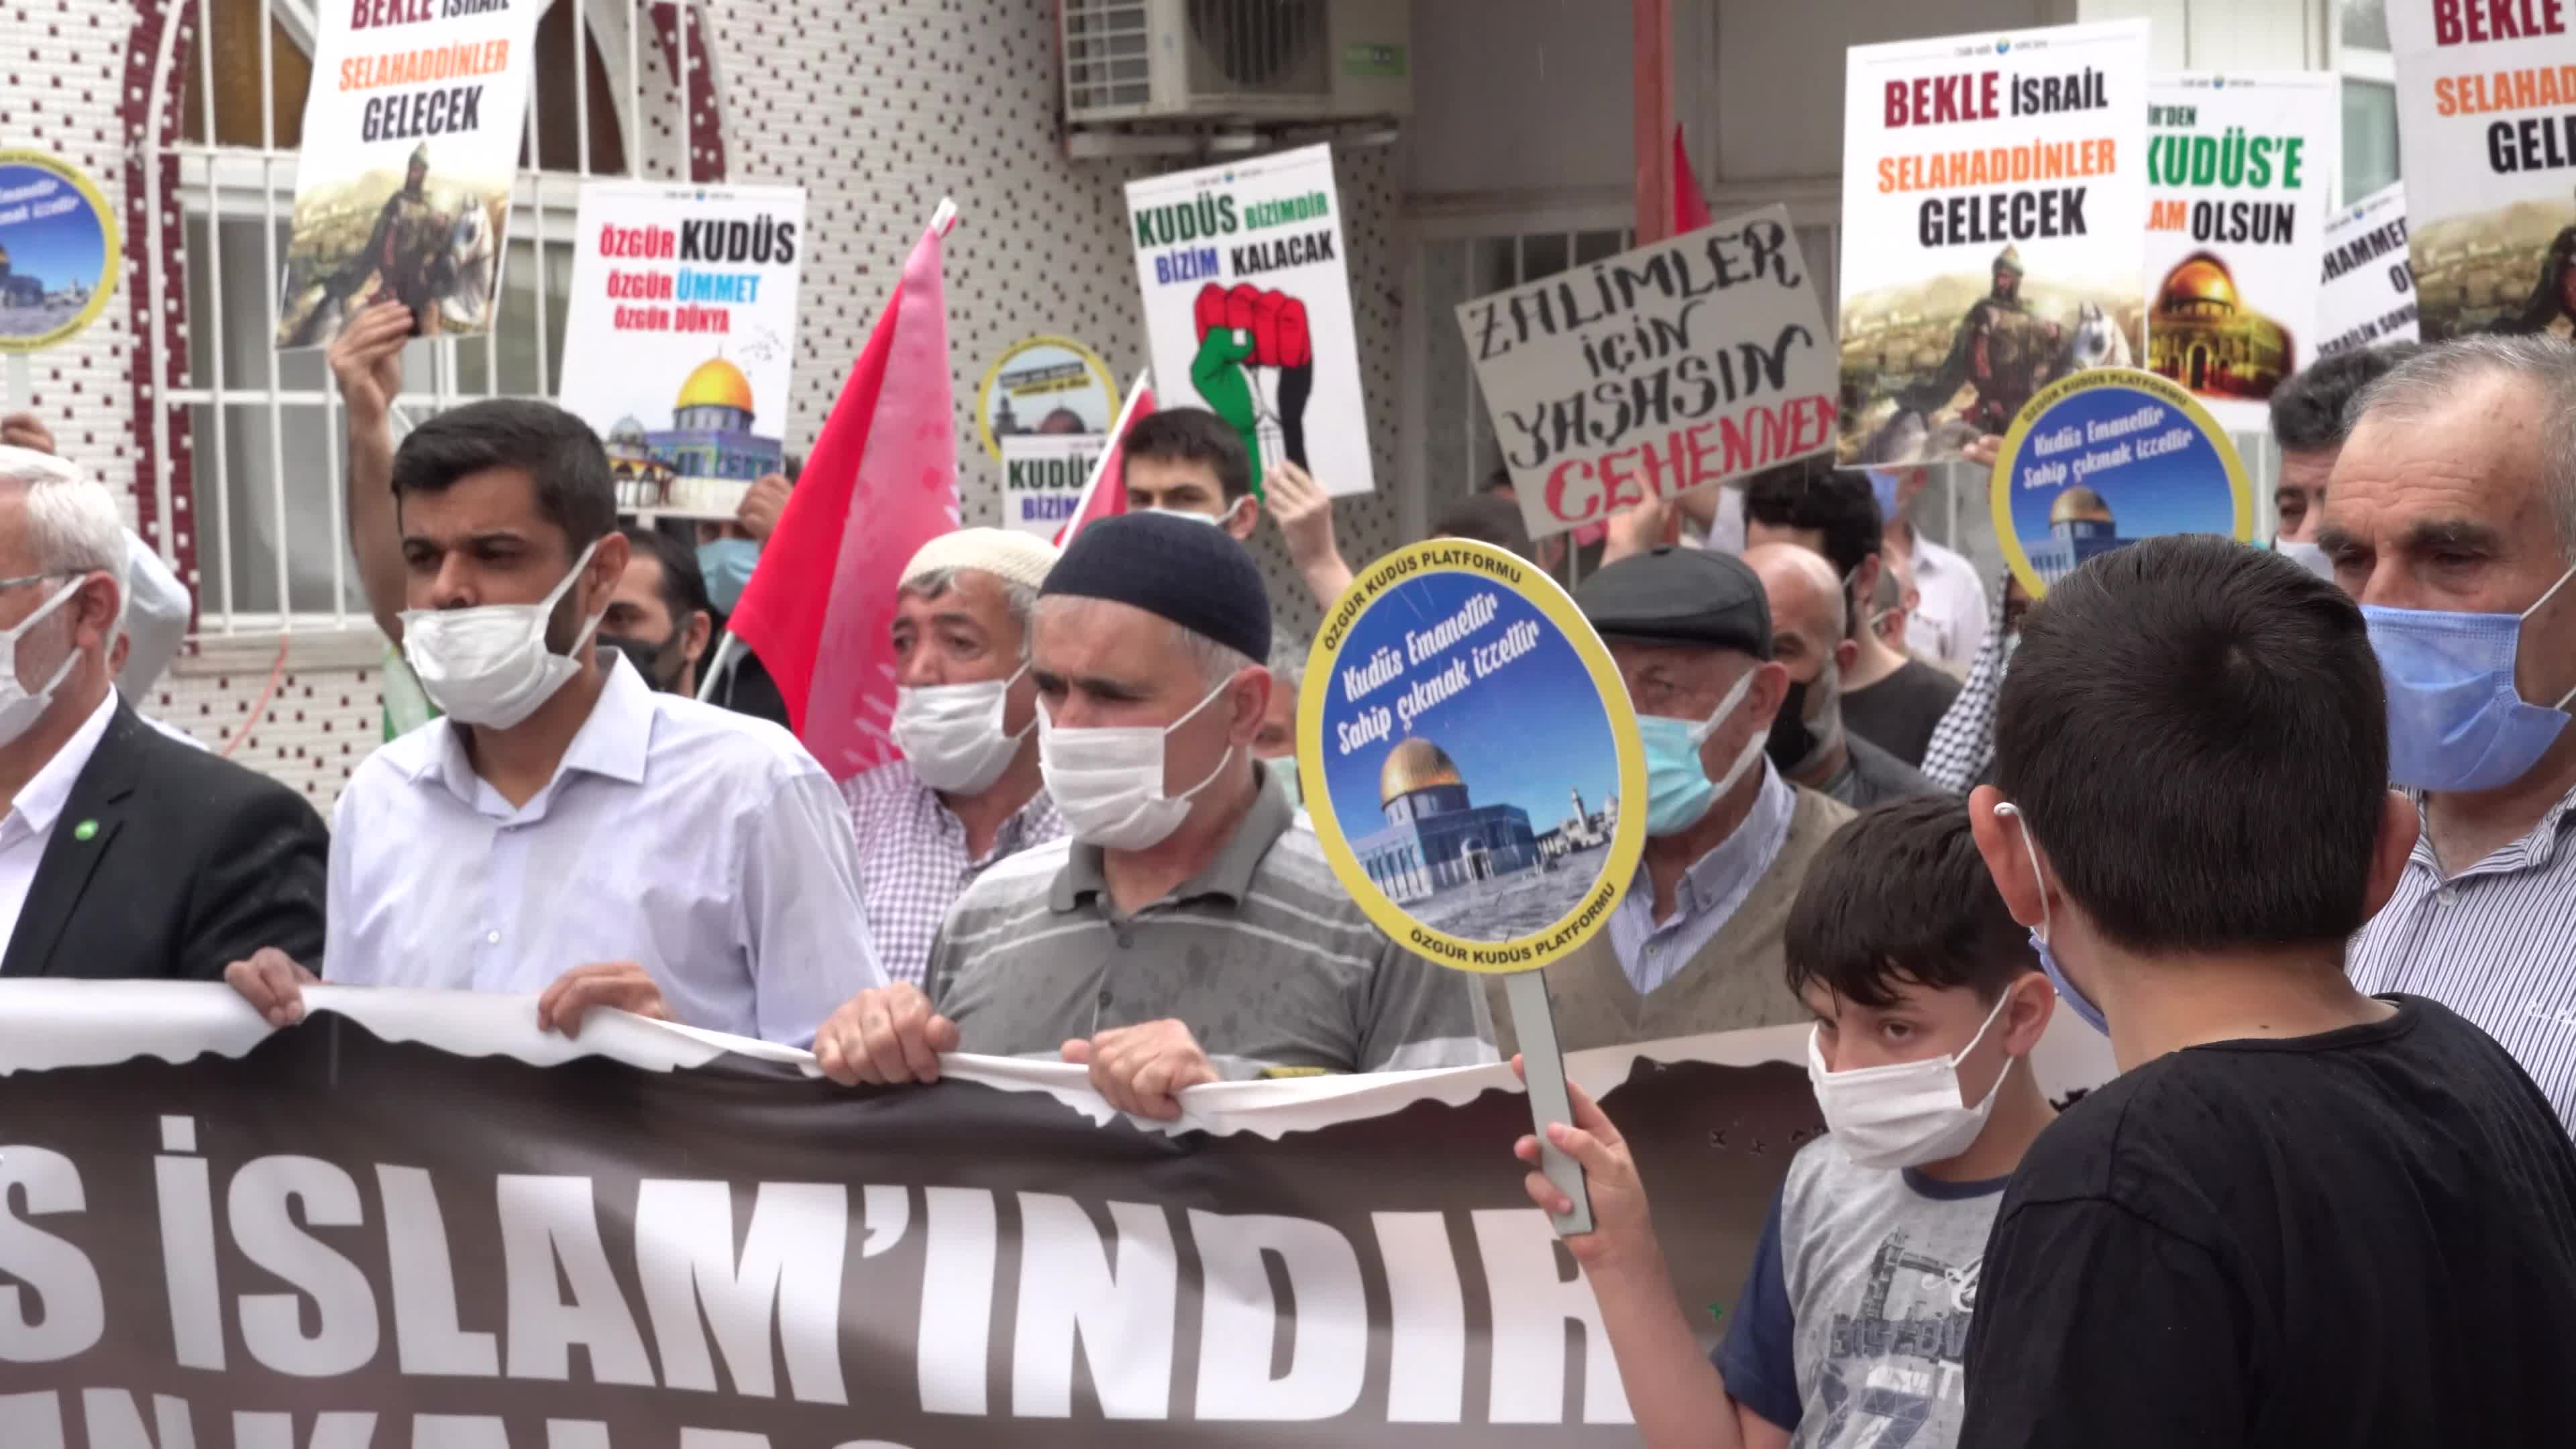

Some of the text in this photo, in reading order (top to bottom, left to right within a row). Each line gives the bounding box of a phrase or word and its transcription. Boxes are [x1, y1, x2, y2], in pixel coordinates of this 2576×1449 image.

[2433, 0, 2566, 46] BEKLE
[339, 38, 510, 93] SELAHADDİNLER
[362, 85, 483, 143] GELECEK
[1884, 66, 2108, 128] BEKLE İSRAİL
[1877, 137, 2116, 194] SELAHADDİNLER
[599, 215, 796, 264] ÖZGÜR KUDÜS
[1135, 191, 1328, 249] KUDÜS BİZİMDİR
[1919, 186, 2087, 248] GELECEK
[2145, 201, 2187, 231] AM
[2192, 201, 2295, 245] OLSUN
[606, 268, 761, 303] ÖZGÜR ÜMMET
[1155, 230, 1335, 284] BİZİM KALACAK
[614, 303, 730, 333] ÖZGÜR DÜNYA
[1469, 220, 1801, 360] ZALİMLER
[2023, 461, 2067, 489] Sahip
[1325, 550, 1521, 650] ÖZGÜR KUDÜS PLATFORMU
[1342, 593, 1498, 702] Kudüs Emanettir
[1337, 706, 1392, 755] Sahip
[1397, 657, 1471, 733] çıkmak
[1410, 882, 1615, 964] ÖZGÜR KUDÜS PLATFORMU
